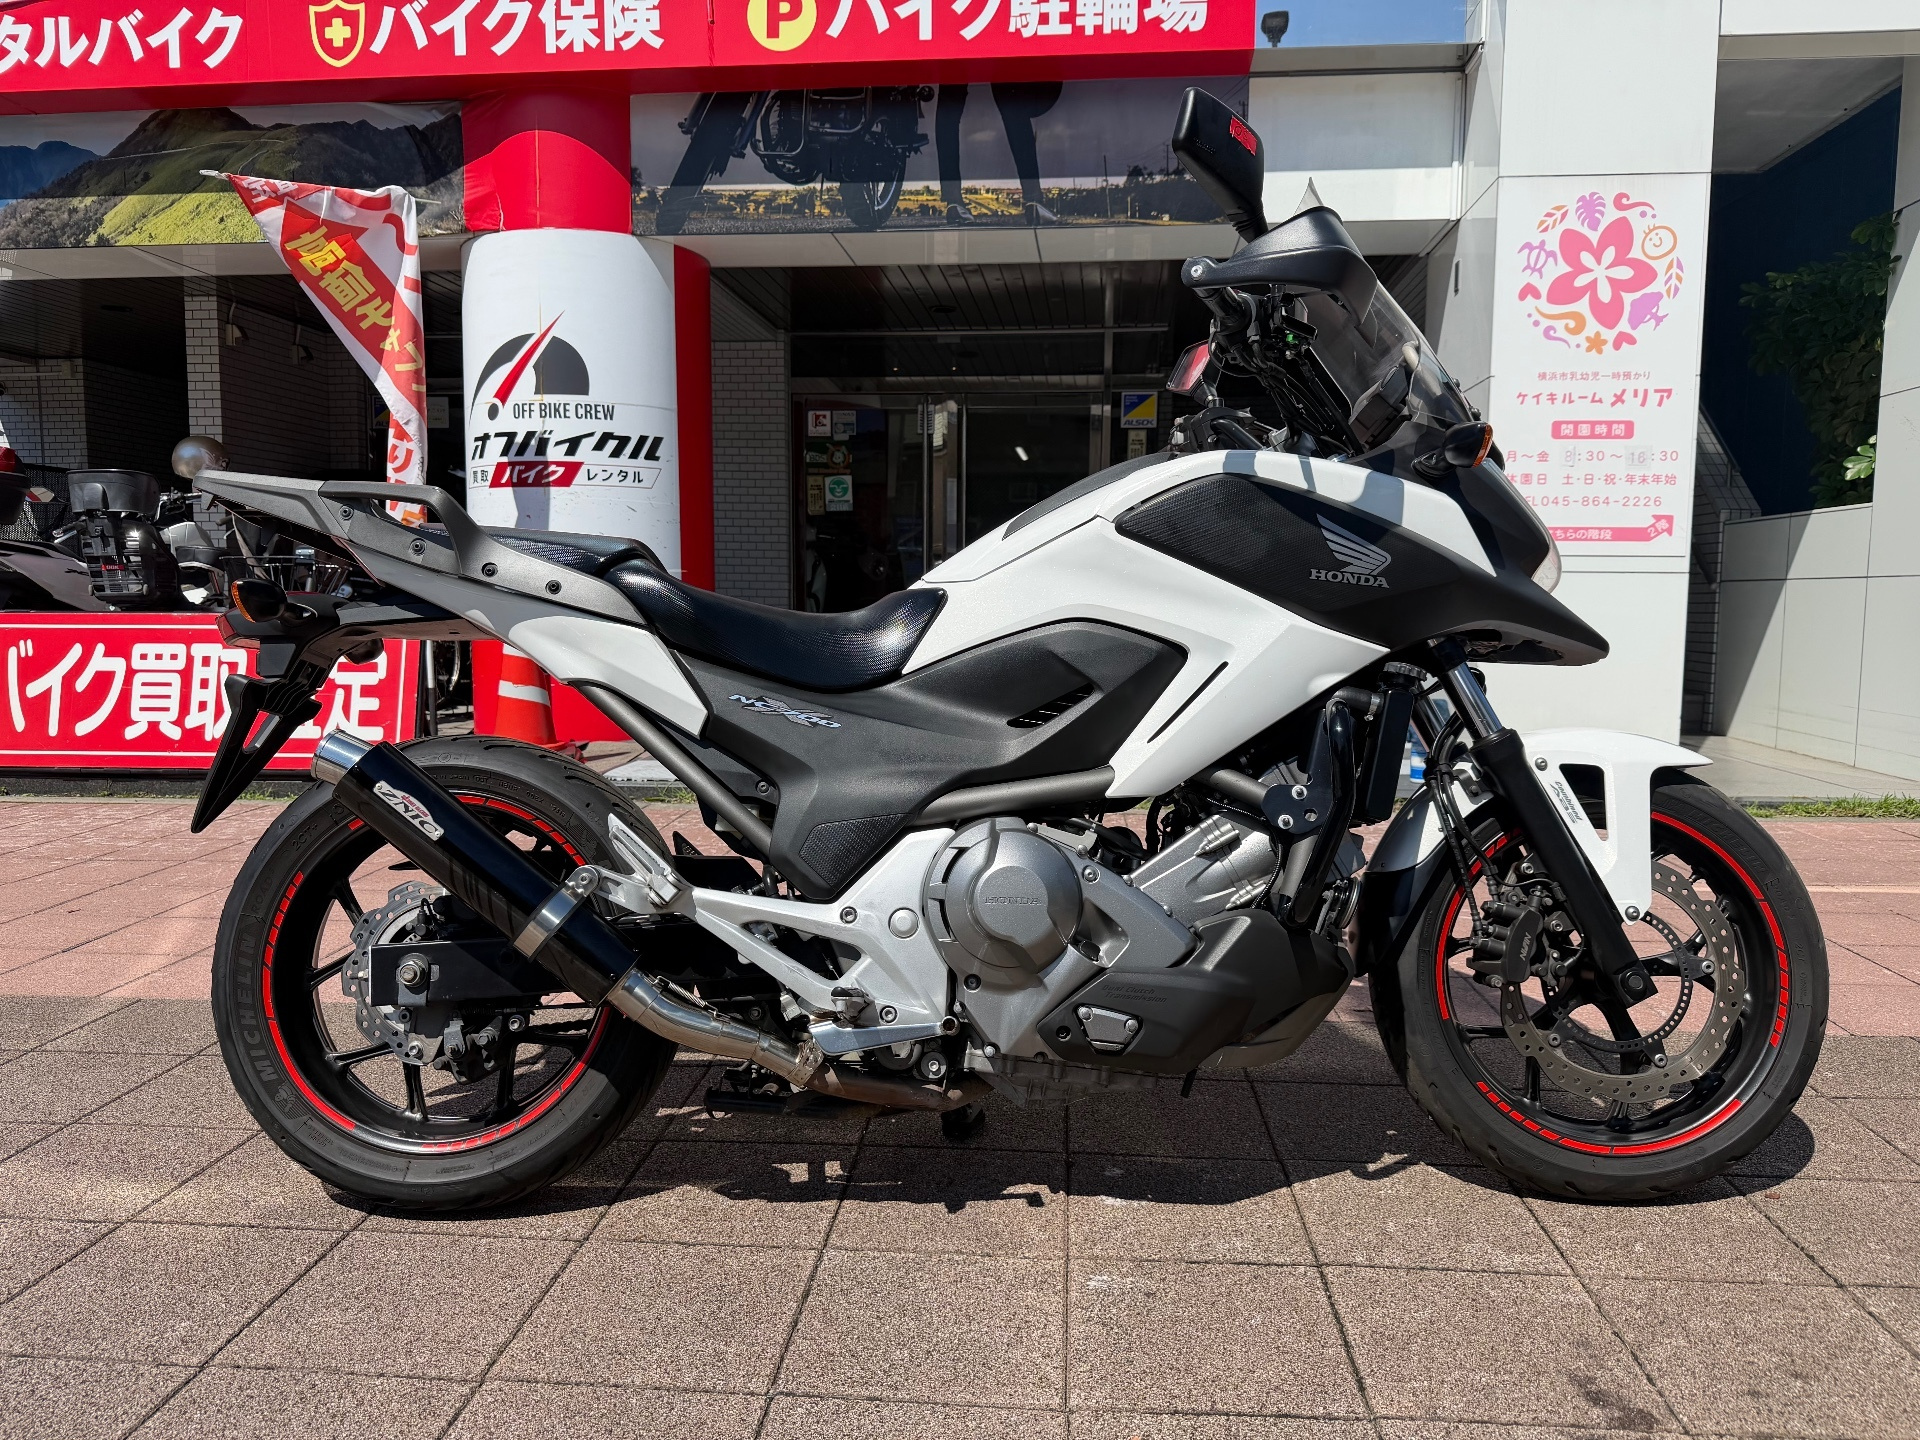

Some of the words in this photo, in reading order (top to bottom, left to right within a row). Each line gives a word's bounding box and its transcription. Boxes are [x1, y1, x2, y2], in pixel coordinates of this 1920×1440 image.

[369, 0, 665, 56] バイク保険
[1537, 371, 1651, 382] 横浜市乳幼児一時預かり
[1516, 391, 1604, 406] ケイキルーム
[1610, 388, 1673, 408] メリア
[512, 402, 535, 419] OFF
[539, 402, 570, 419] BIKE
[575, 403, 615, 421] CREW
[1123, 418, 1155, 427] ALSOK
[1560, 423, 1626, 437] 開園時間
[471, 429, 664, 461] オフバイクル
[472, 469, 489, 484] 買取
[500, 464, 565, 484] バイク
[586, 468, 644, 484] レンタル
[1309, 568, 1390, 589] HONDA
[7, 638, 388, 742] バイク買取定
[985, 896, 1042, 906] HONDA
[236, 918, 279, 1084] MICHELIN
